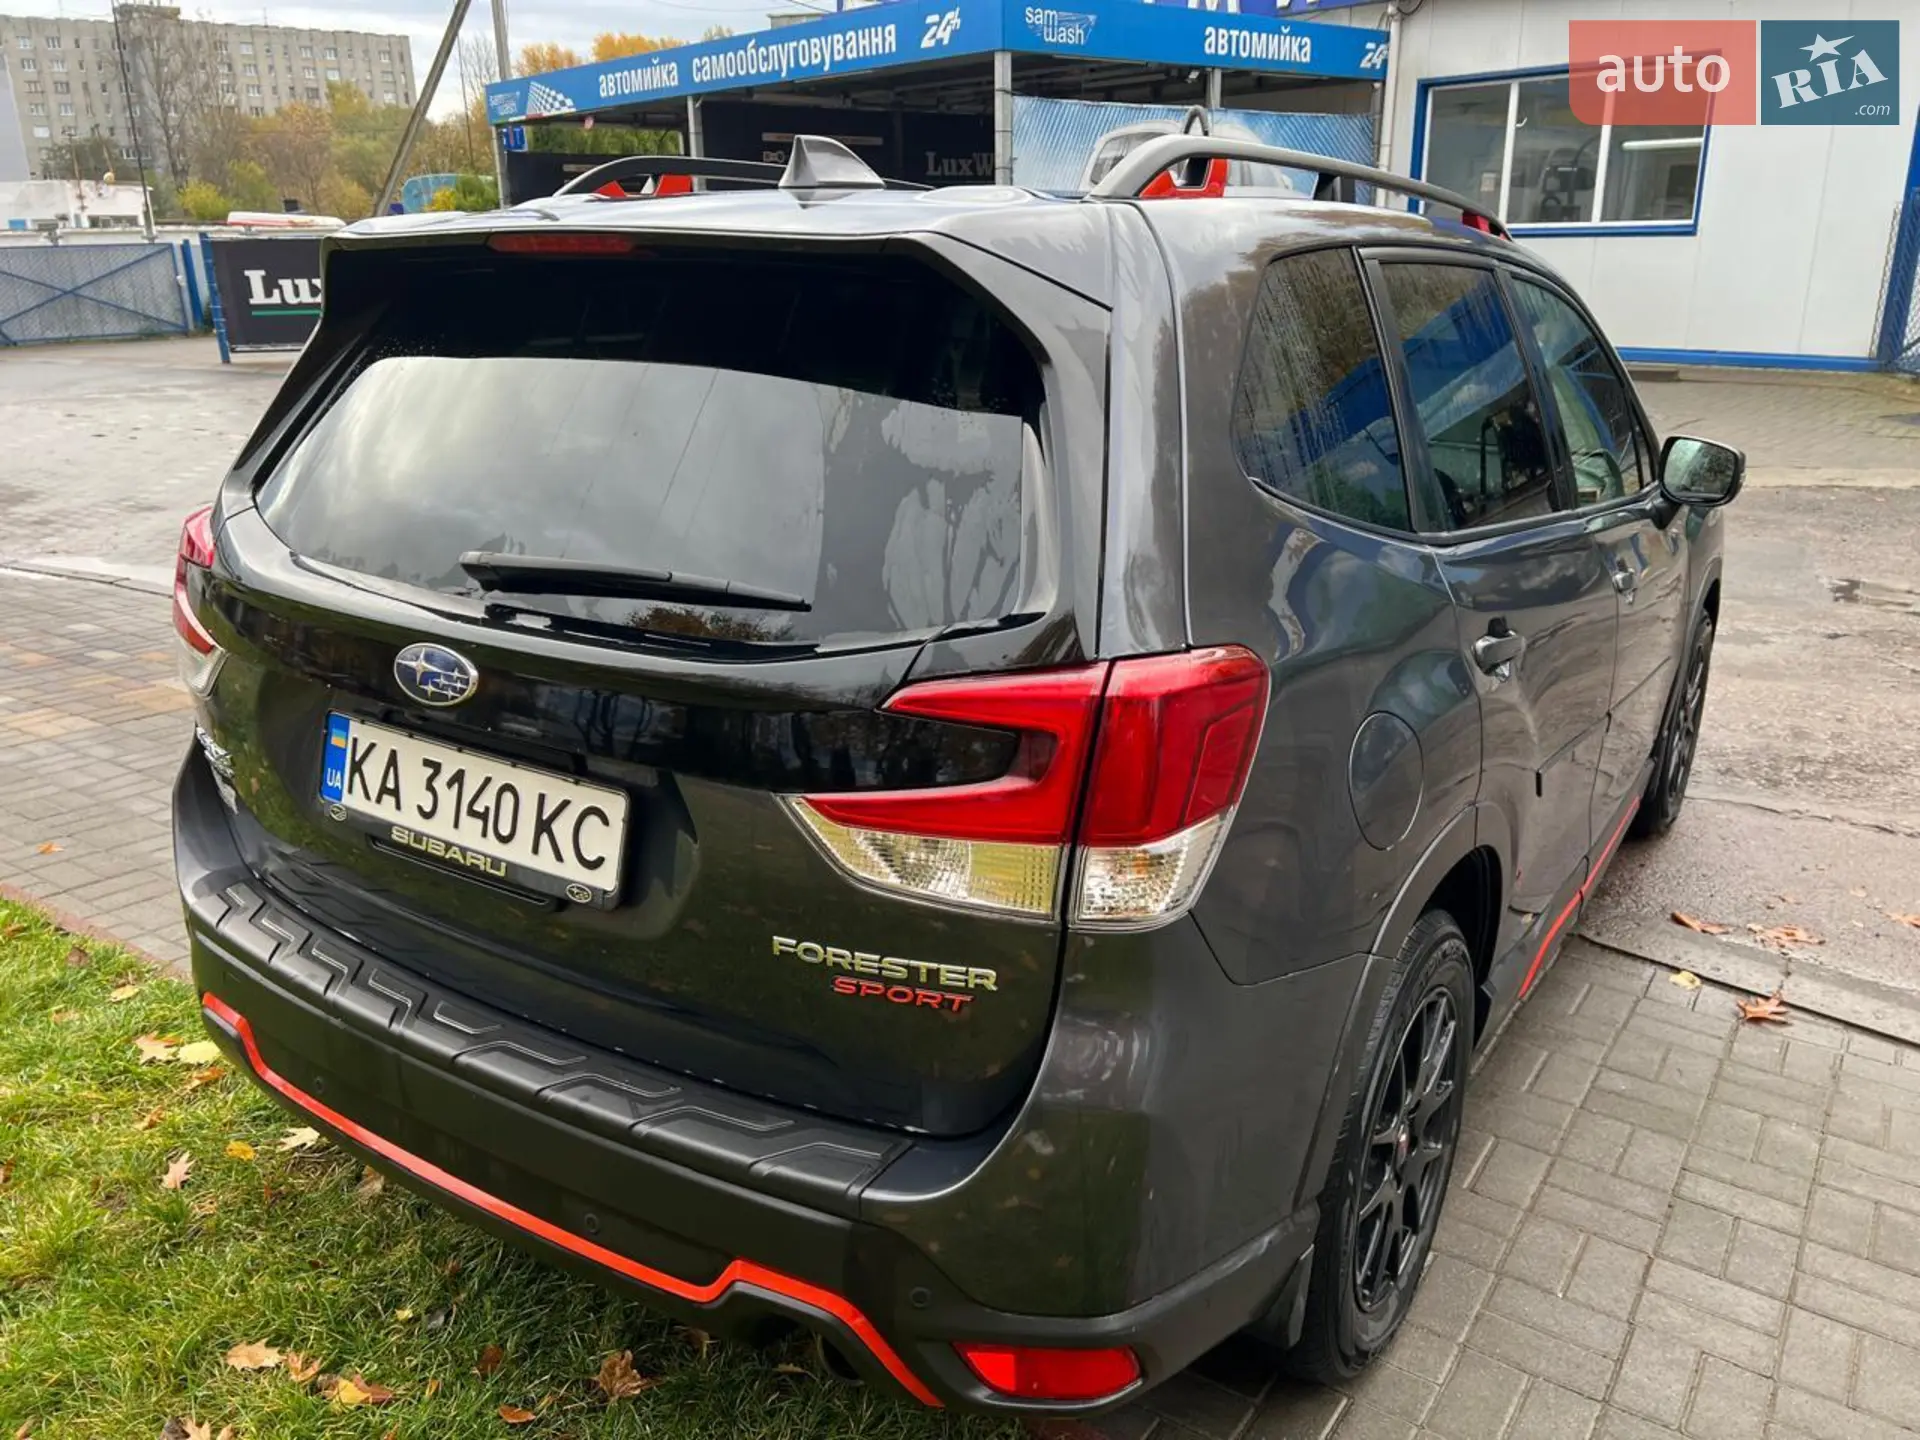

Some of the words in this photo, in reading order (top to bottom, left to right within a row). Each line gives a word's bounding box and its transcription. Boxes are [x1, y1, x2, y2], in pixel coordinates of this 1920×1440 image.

[1025, 6, 1058, 26] sam
[599, 57, 679, 98] автомийка
[692, 23, 897, 84] самообслуговування
[1204, 25, 1312, 63] автомийка
[326, 768, 343, 789] UA
[347, 736, 402, 812] KA
[416, 757, 520, 845] 3140
[530, 792, 611, 871] KC
[390, 825, 507, 878] SUBARU
[772, 935, 998, 991] FORESTER
[833, 975, 974, 1012] SPORT
